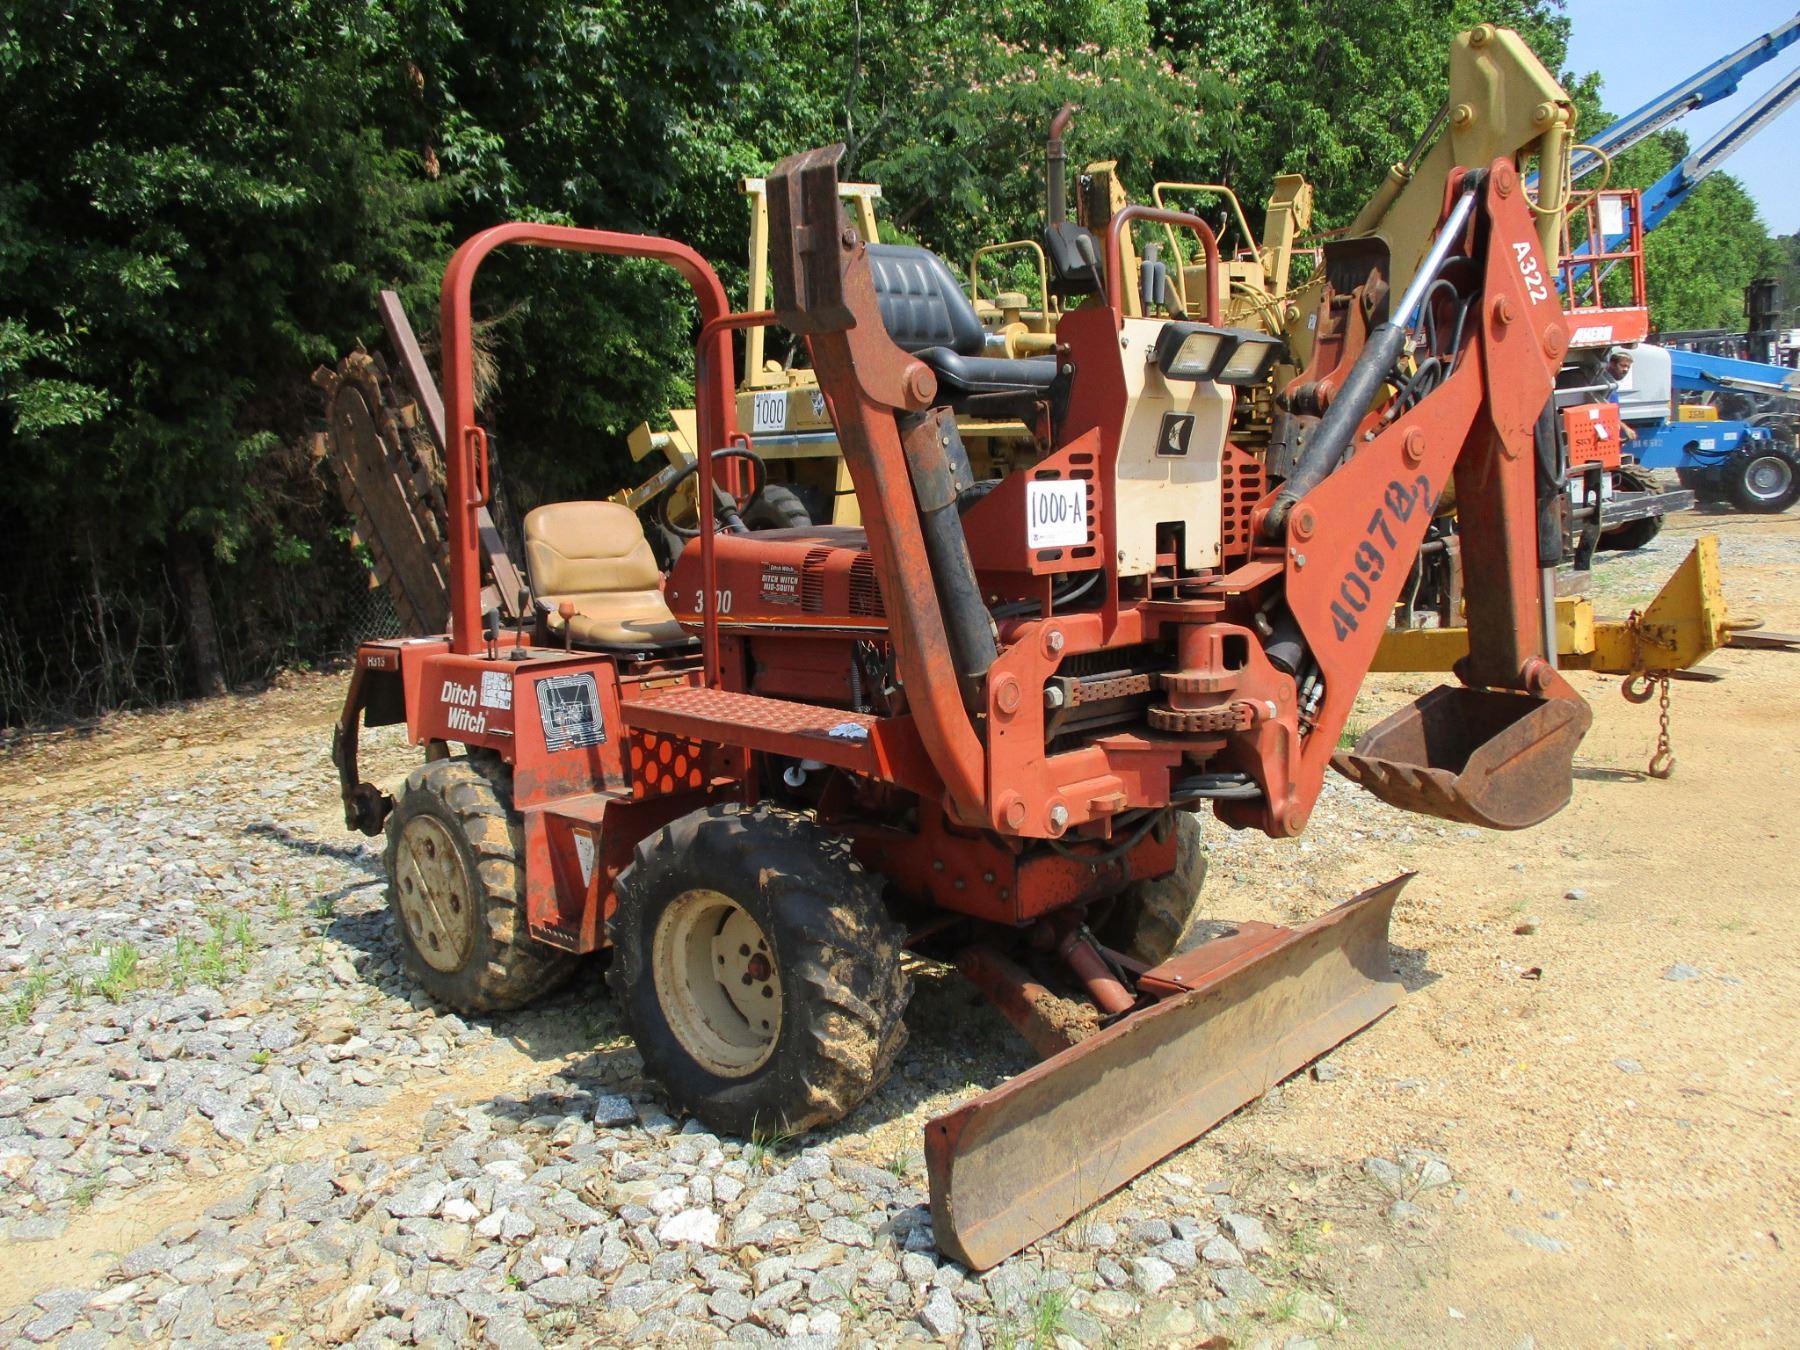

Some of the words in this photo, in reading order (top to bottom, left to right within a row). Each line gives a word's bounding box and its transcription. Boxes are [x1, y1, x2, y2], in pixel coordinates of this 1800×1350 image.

[1512, 242, 1548, 305] A322
[756, 399, 784, 424] 1000
[1032, 491, 1082, 528] 1000-A
[761, 574, 778, 582] DITCH
[780, 576, 798, 584] WITCH
[763, 583, 795, 592] MID-SOUTH
[694, 590, 732, 613] 300
[441, 680, 478, 707] Ditch
[447, 706, 486, 734] Witch
